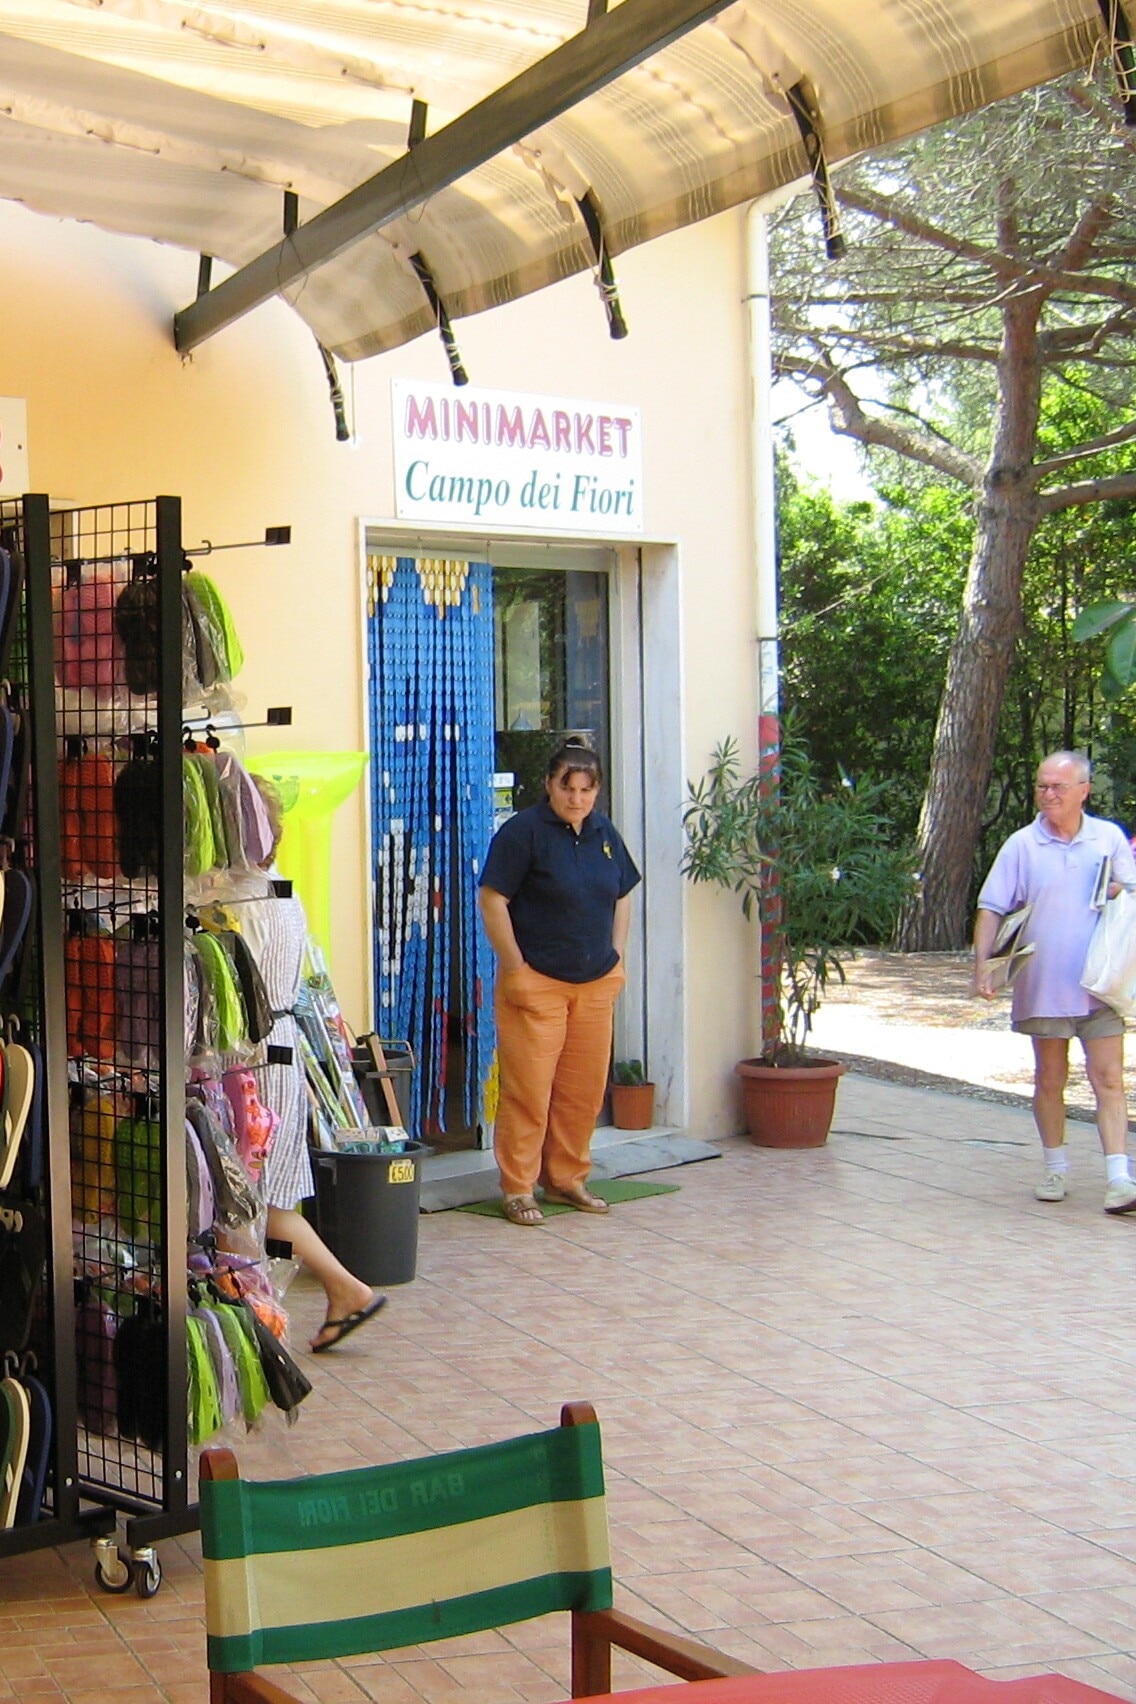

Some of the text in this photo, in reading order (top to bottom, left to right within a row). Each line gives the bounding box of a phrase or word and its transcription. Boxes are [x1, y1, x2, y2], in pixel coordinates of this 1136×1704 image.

[404, 394, 633, 458] MINIMARKET
[405, 460, 634, 516] Campo dei Fiori
